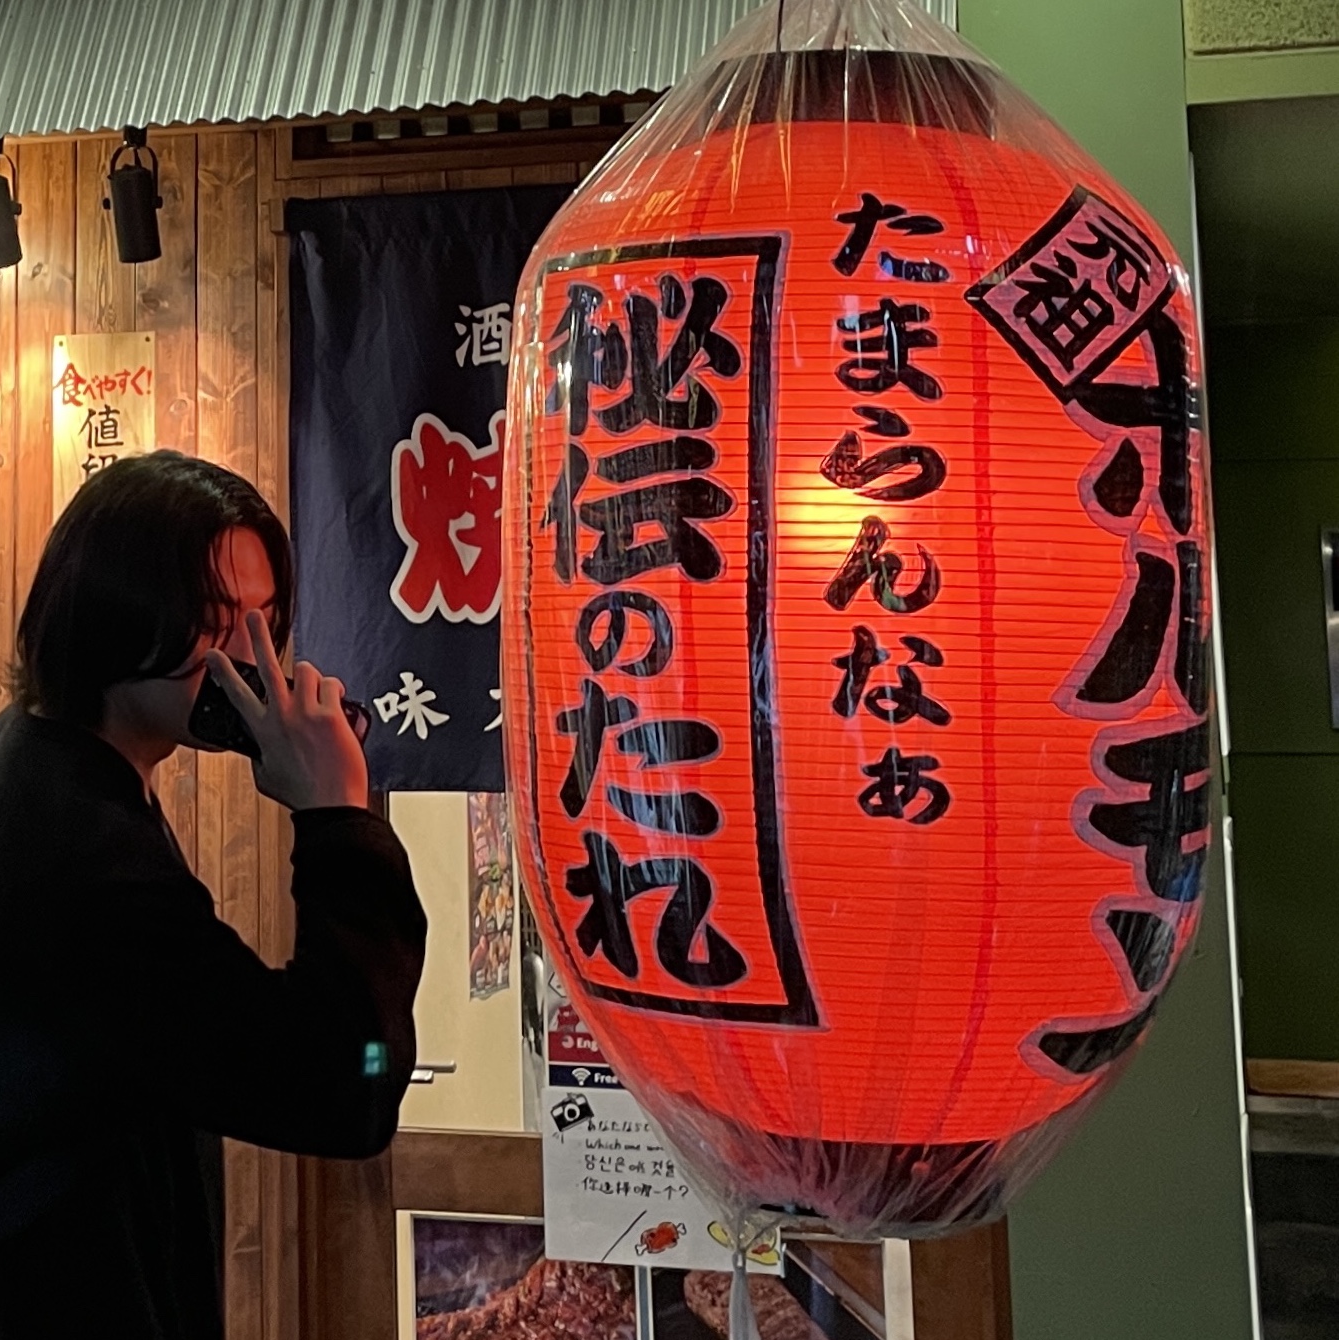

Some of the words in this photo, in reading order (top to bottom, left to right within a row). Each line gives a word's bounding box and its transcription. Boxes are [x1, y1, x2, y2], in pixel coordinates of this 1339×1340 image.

[1012, 213, 1152, 374] 元祖
[454, 303, 513, 368] 酒
[53, 362, 153, 407] 食べやすく!
[820, 190, 954, 826] たまらんなぁ
[541, 273, 749, 991] 秘伝のたれ
[373, 671, 451, 742] 味
[585, 1138, 622, 1151] Which
